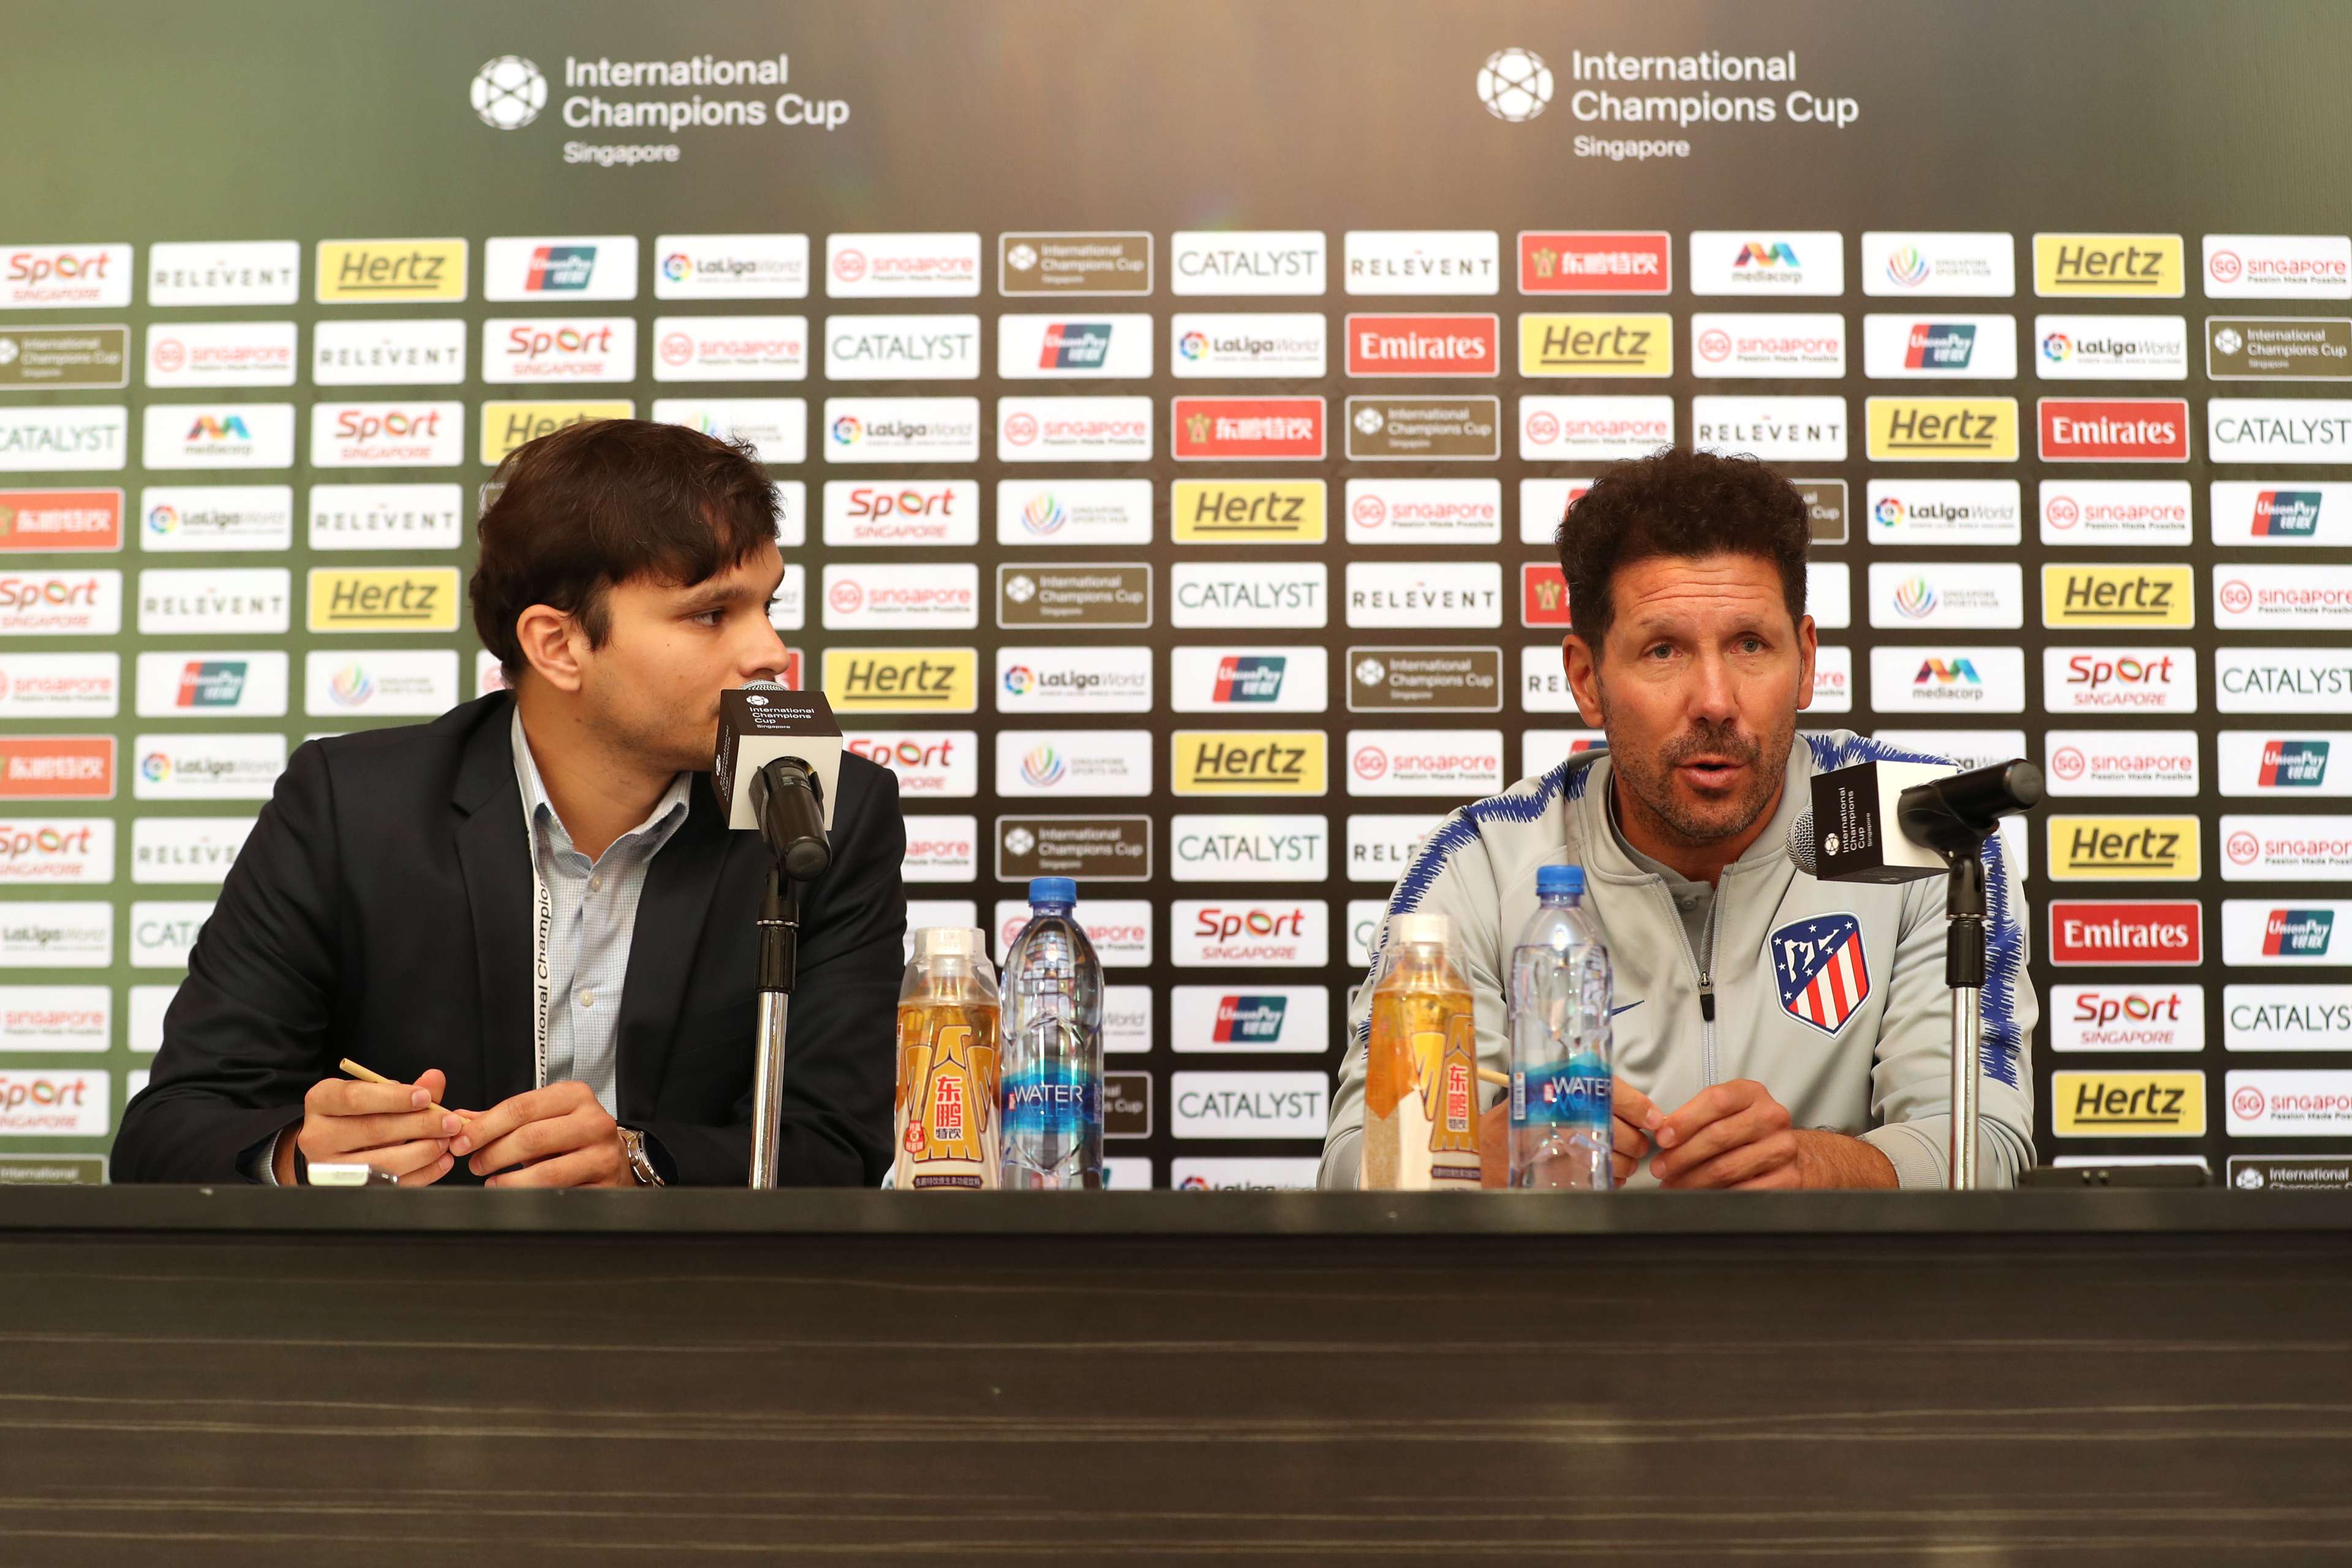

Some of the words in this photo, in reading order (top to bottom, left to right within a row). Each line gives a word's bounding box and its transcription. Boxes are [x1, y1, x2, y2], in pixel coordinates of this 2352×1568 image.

[566, 54, 788, 86] International
[1573, 50, 1795, 81] International
[563, 94, 767, 132] Champions
[775, 94, 850, 130] Cup
[1572, 90, 1776, 127] Champions
[1785, 91, 1859, 128] Cup
[564, 141, 680, 167] Singapore
[1574, 135, 1690, 160] Singapore
[339, 250, 447, 281] Hertz
[1178, 251, 1317, 276] CATALYST
[2056, 245, 2163, 276] Hertz
[1732, 271, 1802, 284] mediacorp
[507, 326, 613, 359] Sport
[833, 334, 971, 360] CATALYST
[1359, 331, 1486, 360] Emirates
[1542, 325, 1651, 356] Hertz
[2247, 329, 2325, 342] International
[2247, 343, 2318, 358] Champions
[2321, 344, 2347, 359] Cup
[335, 410, 441, 443] Sport
[1389, 407, 1469, 420] International
[1889, 409, 1997, 439] Hertz
[1389, 421, 1461, 437] Champions
[1465, 421, 1491, 437] Cup
[2051, 417, 2176, 445] Emirates
[2215, 419, 2350, 445] CATALYST
[847, 488, 956, 521] Sport
[1195, 491, 1305, 522] Hertz
[854, 526, 947, 538] SINGAPORE
[331, 579, 439, 610] Hertz
[1179, 582, 1318, 608] CATALYST
[2065, 576, 2173, 606] Hertz
[846, 659, 956, 691] Hertz
[1390, 658, 1471, 671] International
[2067, 655, 2174, 688] Sport
[1390, 673, 1463, 688] Champions
[1467, 673, 1493, 688] Cup
[1912, 687, 1983, 701] mediacorp
[2074, 693, 2166, 705] SINGAPORE
[1195, 742, 1306, 774] Hertz
[1838, 786, 1849, 853] International
[1848, 791, 1856, 851] Champions
[138, 846, 238, 864] RELEVE
[1179, 835, 1319, 861] CATALYST
[2070, 827, 2179, 859] Hertz
[1195, 909, 1305, 941] Sport
[2063, 919, 2188, 948] Emirates
[1202, 947, 1296, 959] SINGAPORE
[2073, 993, 2181, 1026] Sport
[2231, 1005, 2352, 1030] CATALYS
[538, 985, 548, 1088] ernational
[2081, 1031, 2174, 1043] SINGAPORE
[936, 1076, 962, 1128] 东鹏
[1014, 1084, 1084, 1102] WATER
[1180, 1091, 1319, 1117] CATALYST
[2076, 1082, 2185, 1114] Hertz
[935, 1128, 962, 1140] 特饮
[2269, 1168, 2349, 1182] International
